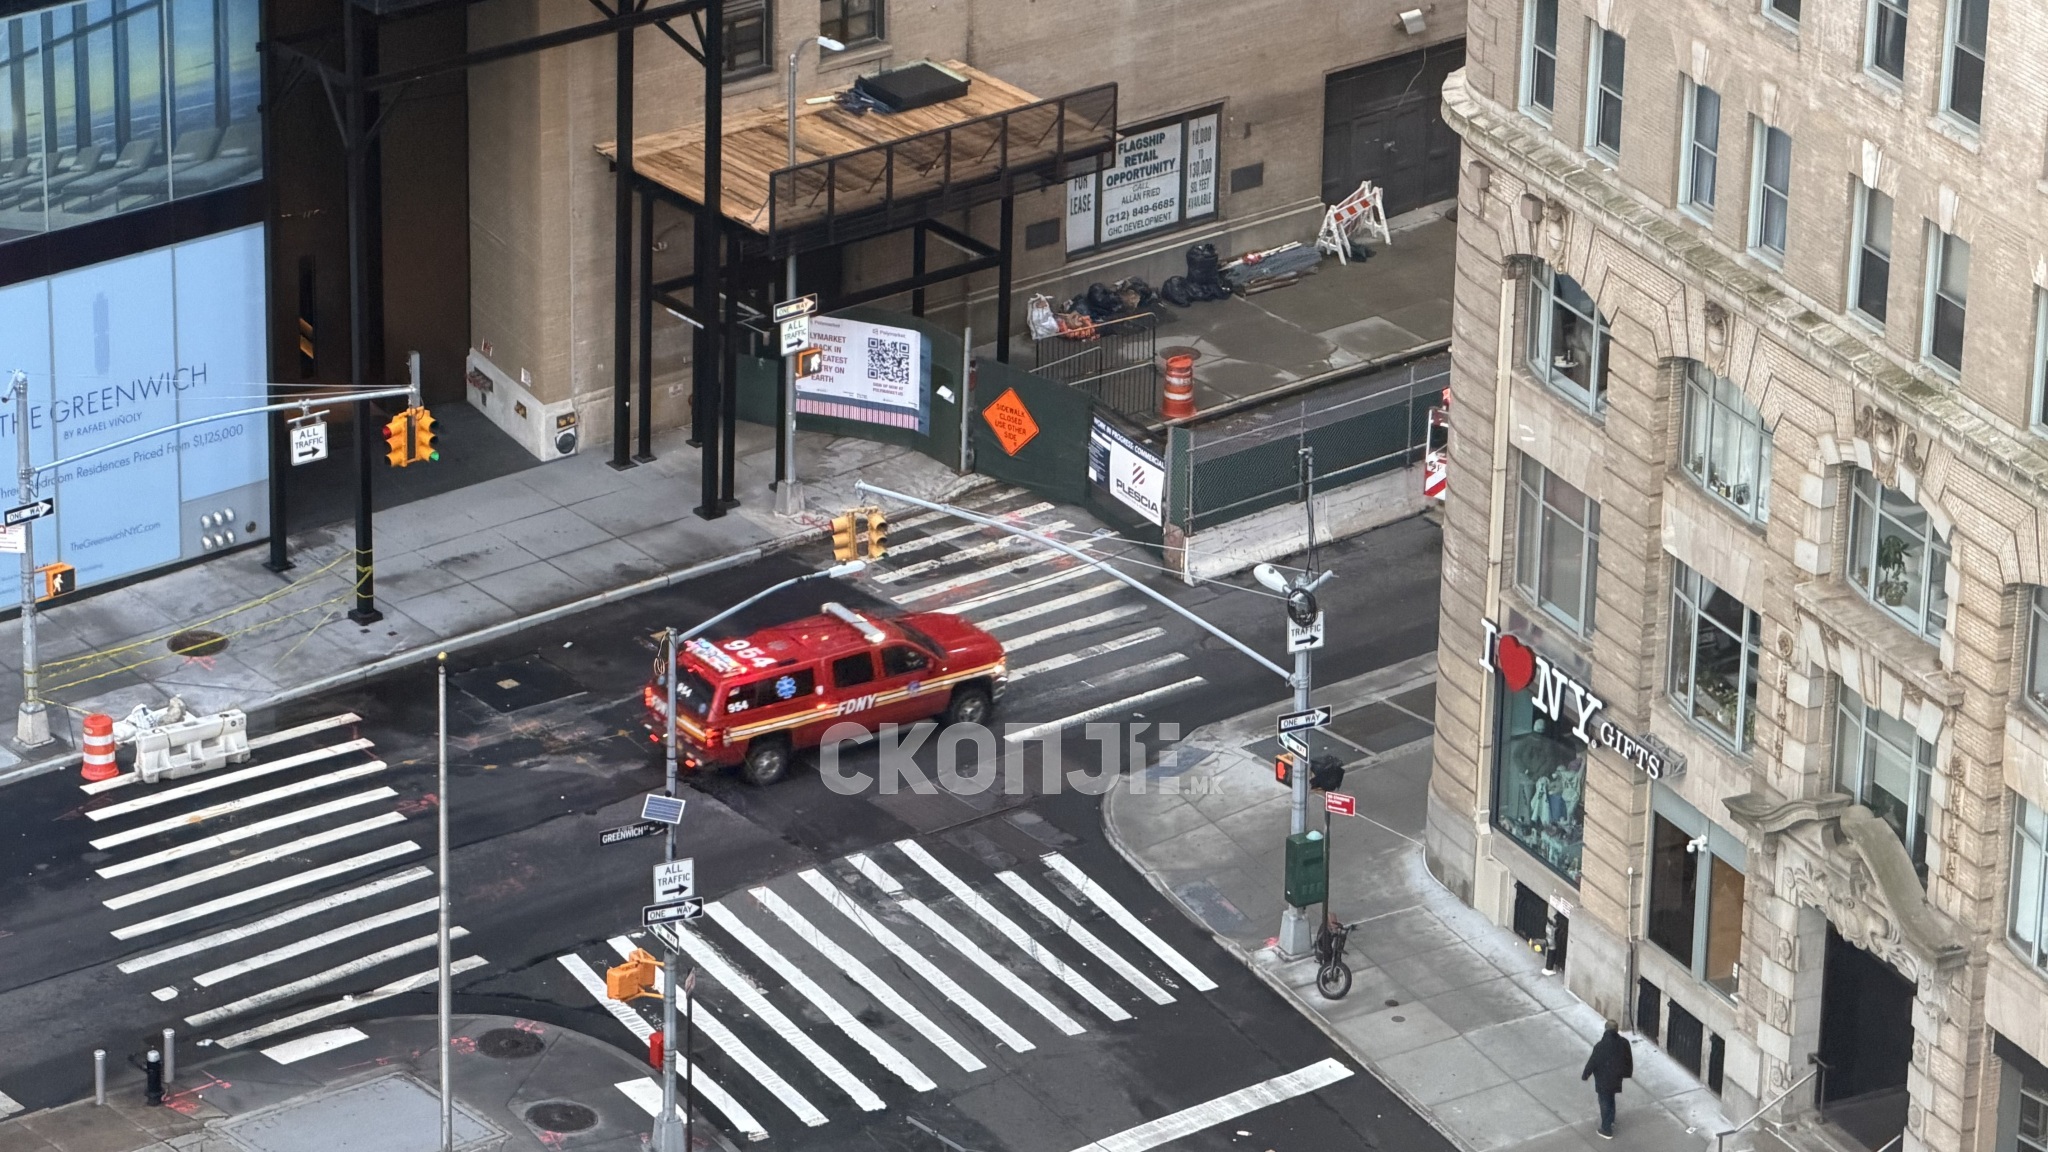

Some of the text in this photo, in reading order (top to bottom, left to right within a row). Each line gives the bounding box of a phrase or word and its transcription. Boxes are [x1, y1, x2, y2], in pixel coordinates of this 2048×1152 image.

[1118, 132, 1166, 155] FLAGSHIP
[1124, 149, 1158, 168] RETAIL
[1106, 157, 1176, 187] OPPORTUNITY
[1132, 181, 1150, 192] CALL
[1121, 187, 1161, 205] ALLAN FRIED
[1187, 192, 1212, 210] AVAILABLE
[1070, 193, 1092, 216] LEASE
[1105, 197, 1175, 226] (212) 849-6685
[1108, 211, 1173, 237] GHC DEVELOPMENT
[796, 302, 809, 311] WAY
[787, 320, 803, 331] ALL
[784, 328, 807, 341] TRAFFIC
[809, 332, 847, 344] LYMARKET
[834, 345, 842, 353] IN
[822, 354, 848, 364] EATEST
[811, 374, 834, 383] EARTH
[834, 366, 845, 375] ON
[50, 362, 207, 423] GREENWICH
[996, 403, 1025, 418] SIDEWALK
[63, 411, 143, 440] BY RAFAEL VIÑOLY
[995, 419, 1027, 436] USE OTHER
[999, 413, 1023, 426] CLOSED
[300, 427, 318, 439] ALL
[1004, 431, 1018, 441] SIDE
[295, 436, 324, 449] TRAFFIC
[76, 457, 131, 479] Residences
[133, 444, 164, 463] Priced
[166, 441, 191, 455] From
[193, 423, 244, 448] $1,125,000
[1134, 445, 1165, 468] COMMERCIAL
[1116, 478, 1159, 514] PLESCIA
[9, 505, 45, 521] ONE WAY
[70, 521, 161, 551] TheGreenwichNYC.com
[1291, 623, 1322, 637] TRAFFIC
[723, 639, 778, 668] 954
[727, 700, 749, 713] 954
[835, 693, 877, 717] FDNY
[1478, 617, 1662, 780] I NY GIFTS
[1283, 713, 1321, 728] ONE WAY
[602, 827, 644, 844] GREENWICH
[665, 863, 683, 875] ALL
[657, 872, 691, 887] TRAFFIC
[650, 904, 693, 920] ONE WAY
